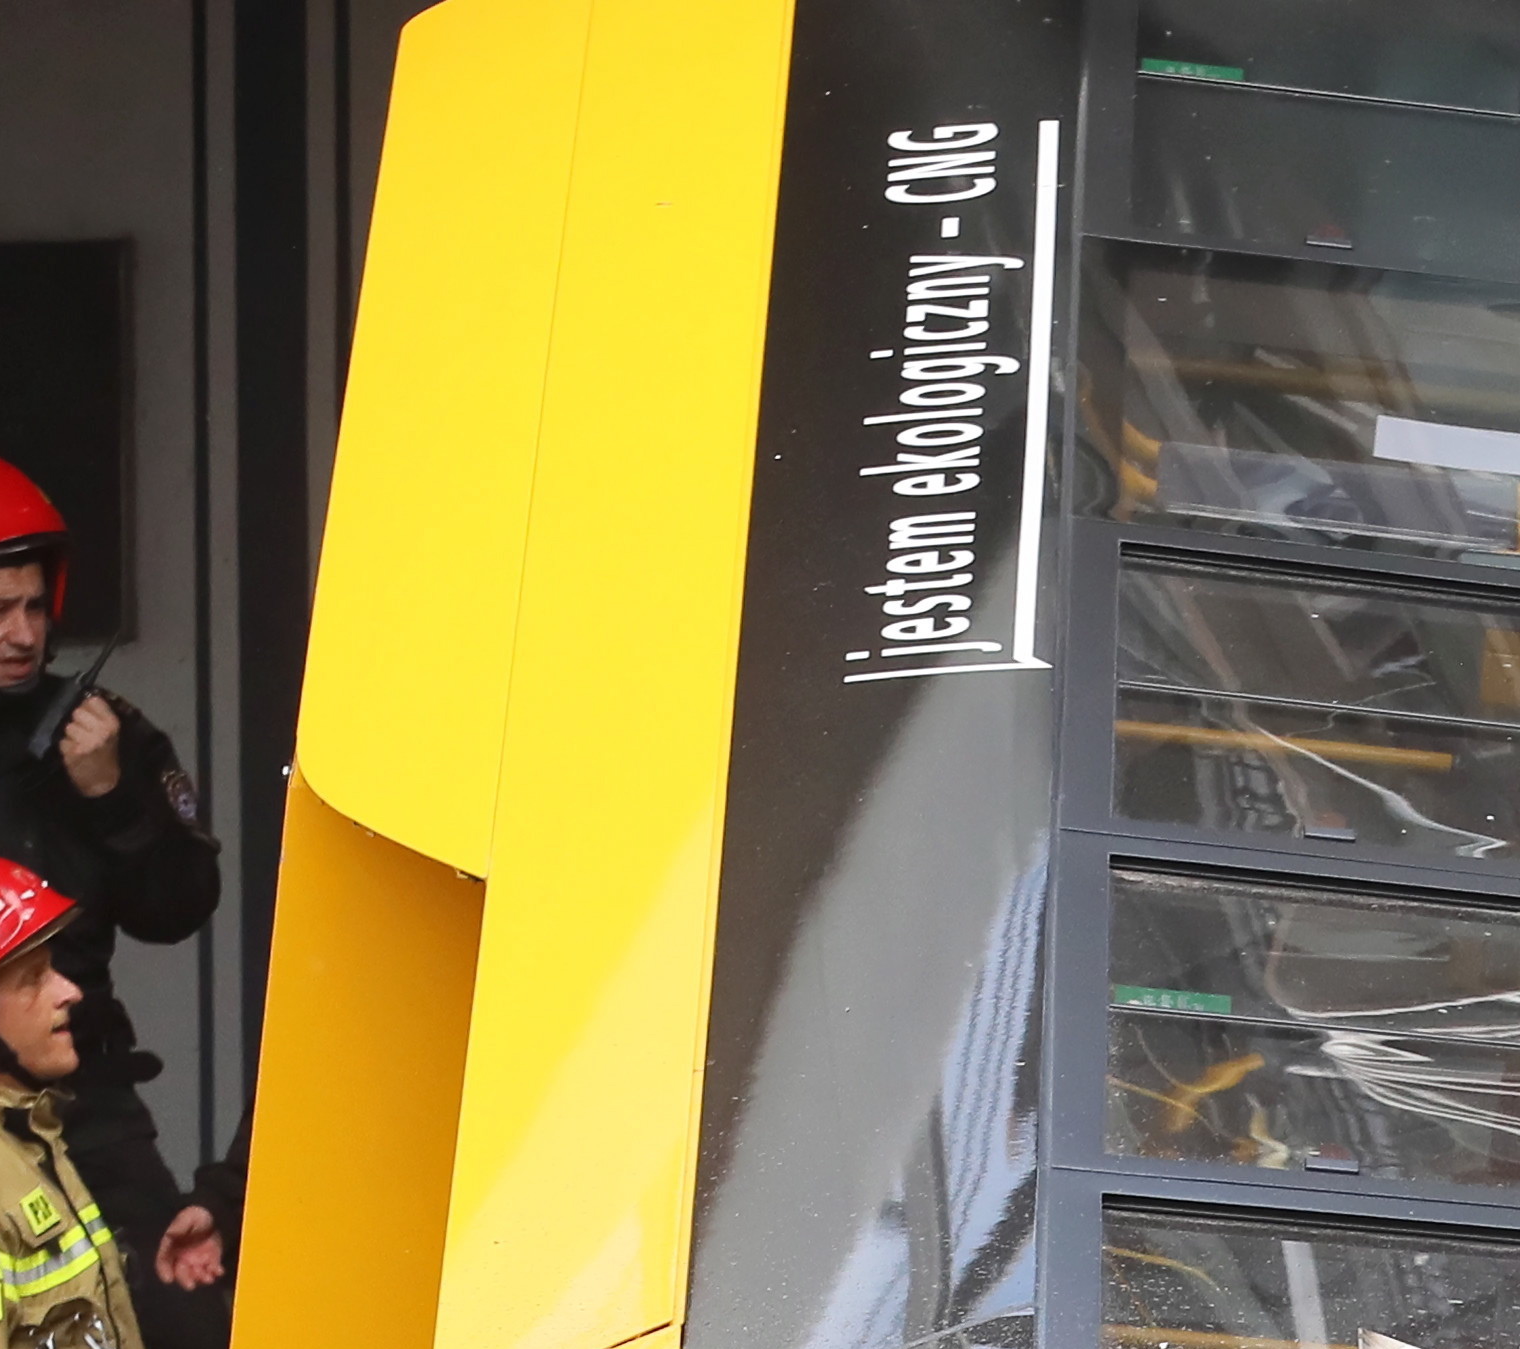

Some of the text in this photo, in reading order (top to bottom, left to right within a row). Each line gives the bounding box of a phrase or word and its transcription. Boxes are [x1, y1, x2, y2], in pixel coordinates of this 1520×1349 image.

[884, 122, 999, 204] CNG
[860, 254, 1025, 497] ekologiczny
[845, 511, 1003, 661] jestem
